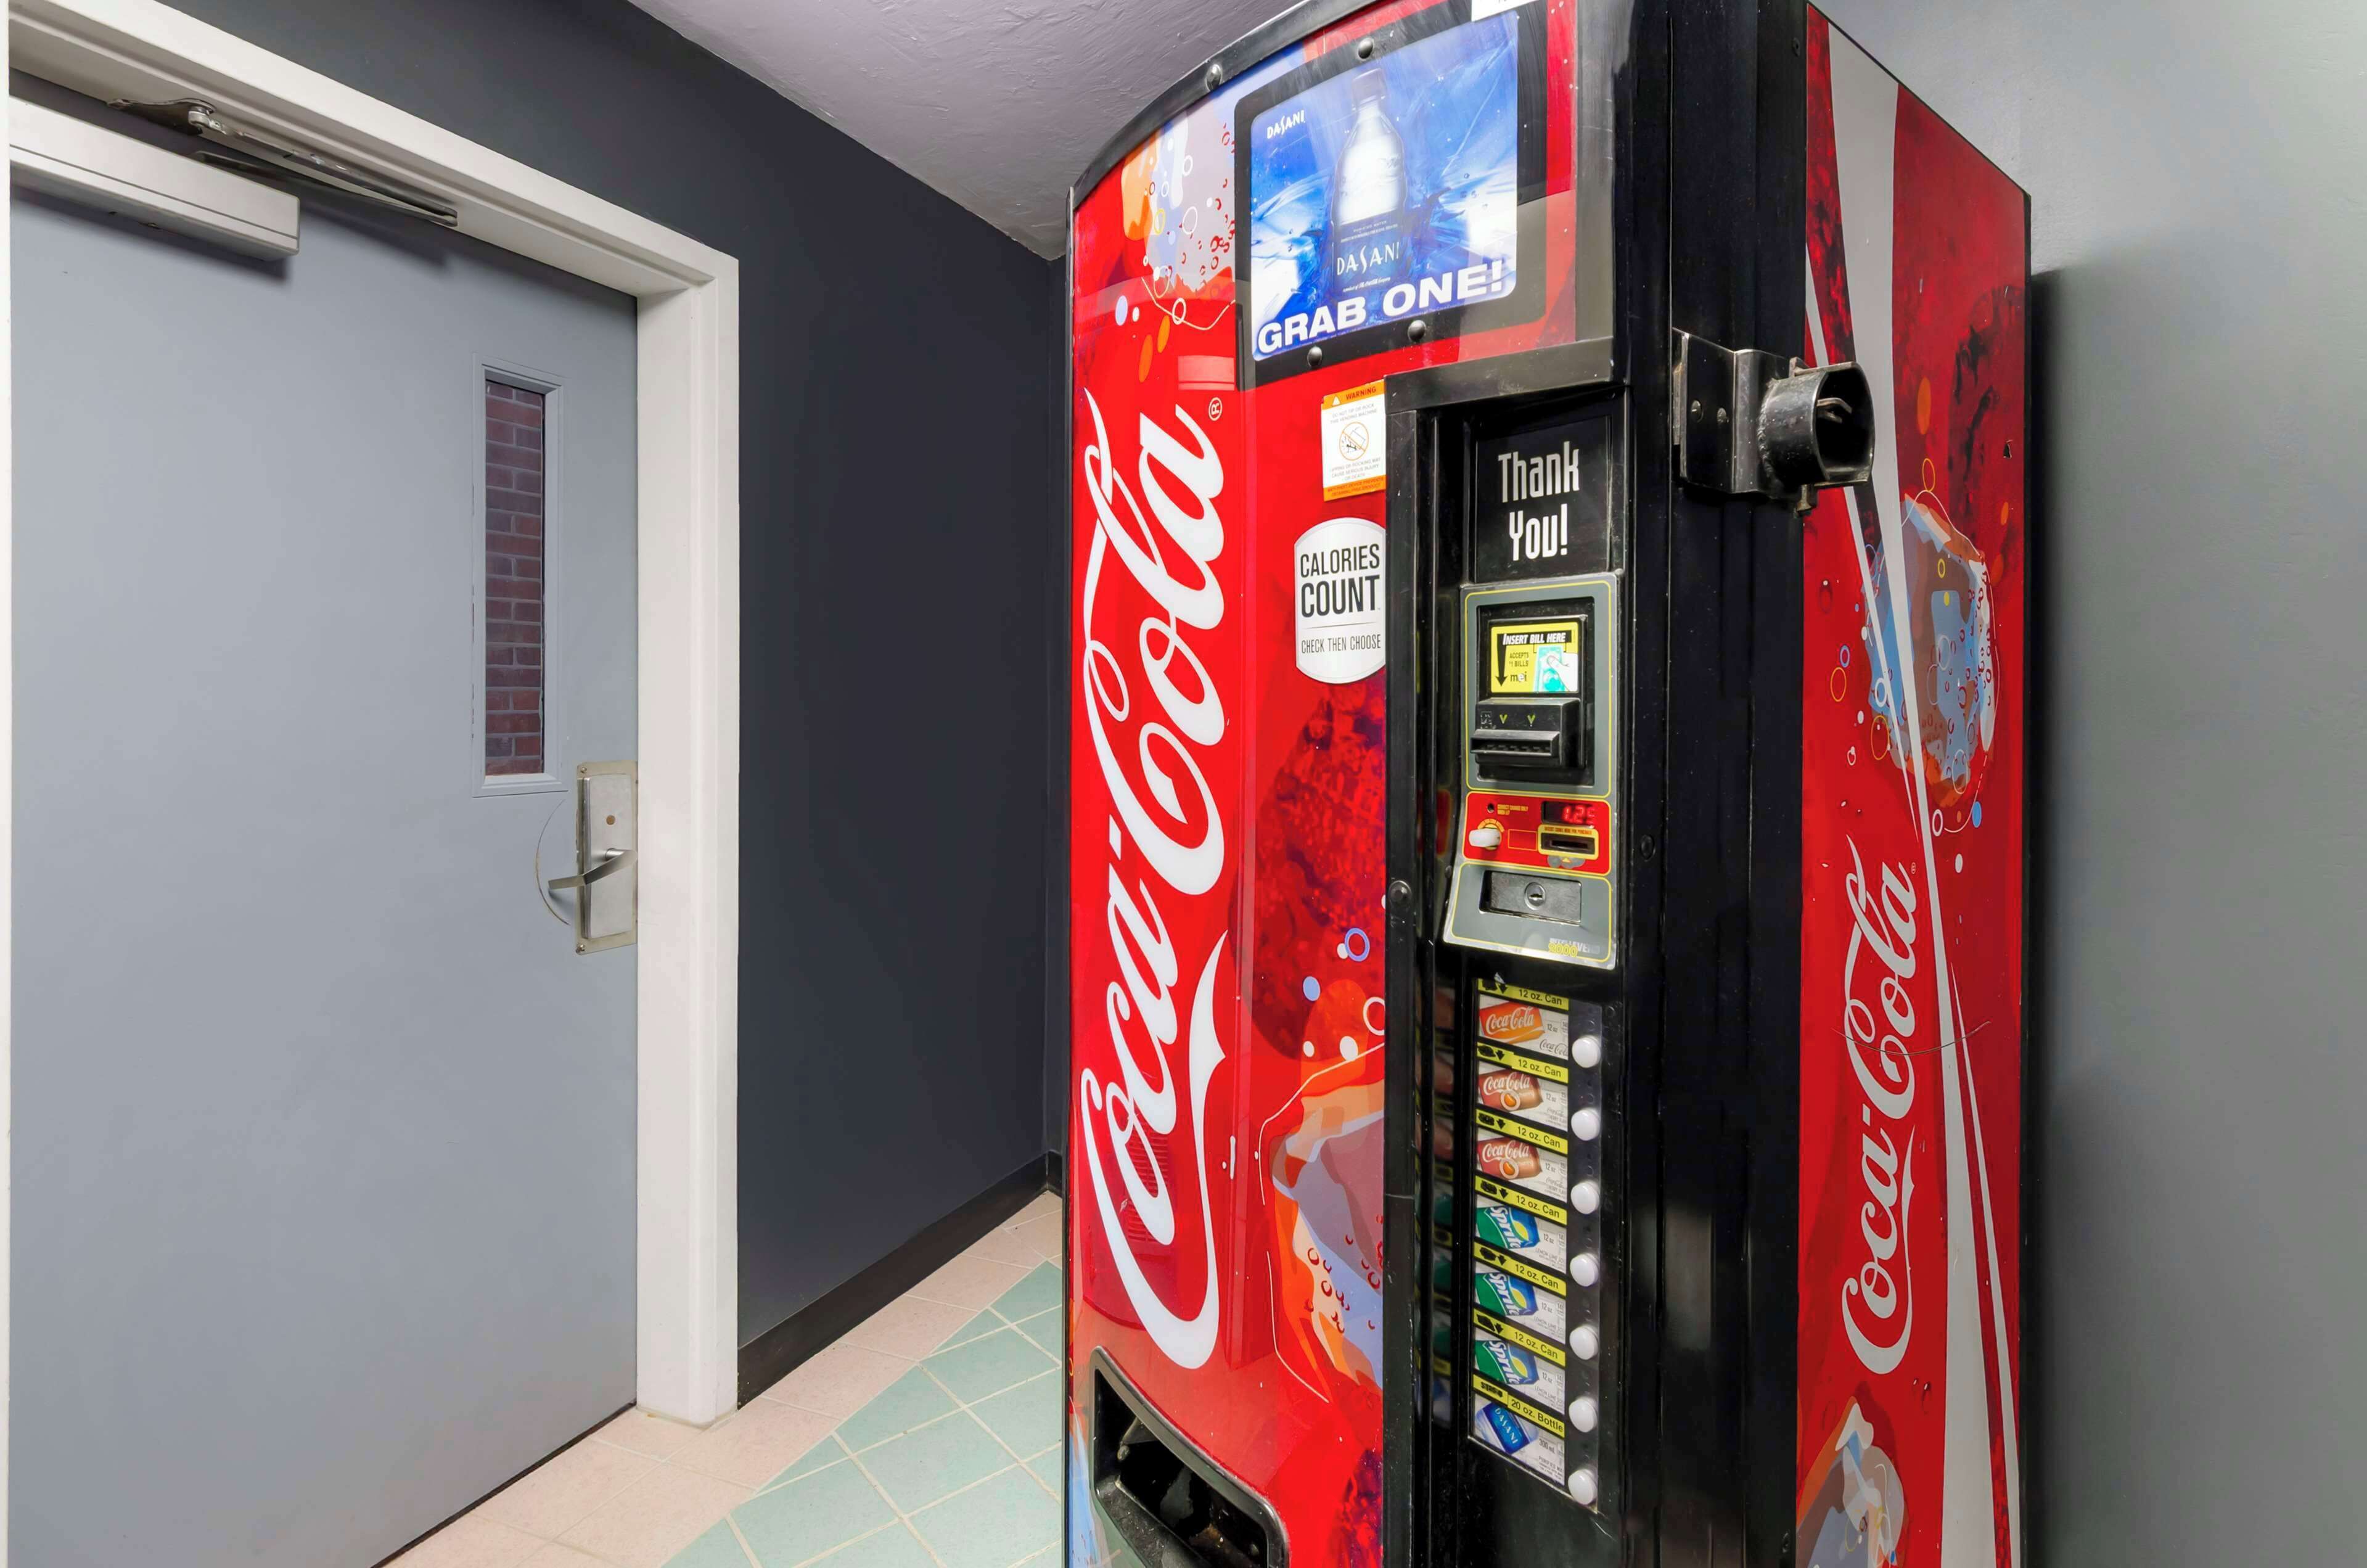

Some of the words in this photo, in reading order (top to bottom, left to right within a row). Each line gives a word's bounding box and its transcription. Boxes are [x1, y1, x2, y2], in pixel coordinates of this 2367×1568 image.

[1266, 110, 1305, 139] DASANI
[1336, 241, 1400, 276] DASANI
[1258, 296, 1367, 354] GRAB
[1383, 260, 1503, 316] ONE!
[1346, 386, 1376, 400] WARNING
[1498, 441, 1580, 503] Thank
[1509, 503, 1567, 561] You!
[1300, 543, 1380, 578] CALORIES
[1301, 574, 1380, 618] COUNT
[1302, 639, 1324, 654] CHECK
[1327, 637, 1347, 652] THEN
[1350, 634, 1381, 651] CHOOSE
[1503, 633, 1528, 646] INSERT
[1530, 633, 1545, 644] BILL
[1546, 632, 1566, 642] HERE
[1519, 989, 1528, 997] 12
[1530, 993, 1543, 1001] oz.
[1545, 995, 1562, 1006] Can
[1519, 1059, 1527, 1069] 12
[1530, 1063, 1541, 1072] oz.
[1544, 1065, 1561, 1077] Can
[1517, 1127, 1527, 1136] 12
[1529, 1131, 1541, 1141] oz.
[1543, 1135, 1561, 1148] Can
[1516, 1196, 1525, 1206] 12
[1528, 1201, 1540, 1211] oz.
[1543, 1205, 1559, 1218] Can
[1490, 1207, 1521, 1249] Sprite
[1515, 1264, 1524, 1275] 12
[1527, 1270, 1539, 1281] oz.
[1541, 1275, 1559, 1289] Can
[1488, 1273, 1520, 1315] Sprite
[1488, 1340, 1520, 1384] Sprite
[1515, 1332, 1524, 1342] 12
[1526, 1339, 1538, 1350] oz.
[1540, 1344, 1558, 1358] Can
[1495, 1408, 1519, 1444] DASANI
[1511, 1399, 1520, 1410] 20
[1523, 1407, 1535, 1418] oz.
[1538, 1413, 1564, 1433] Bottle
